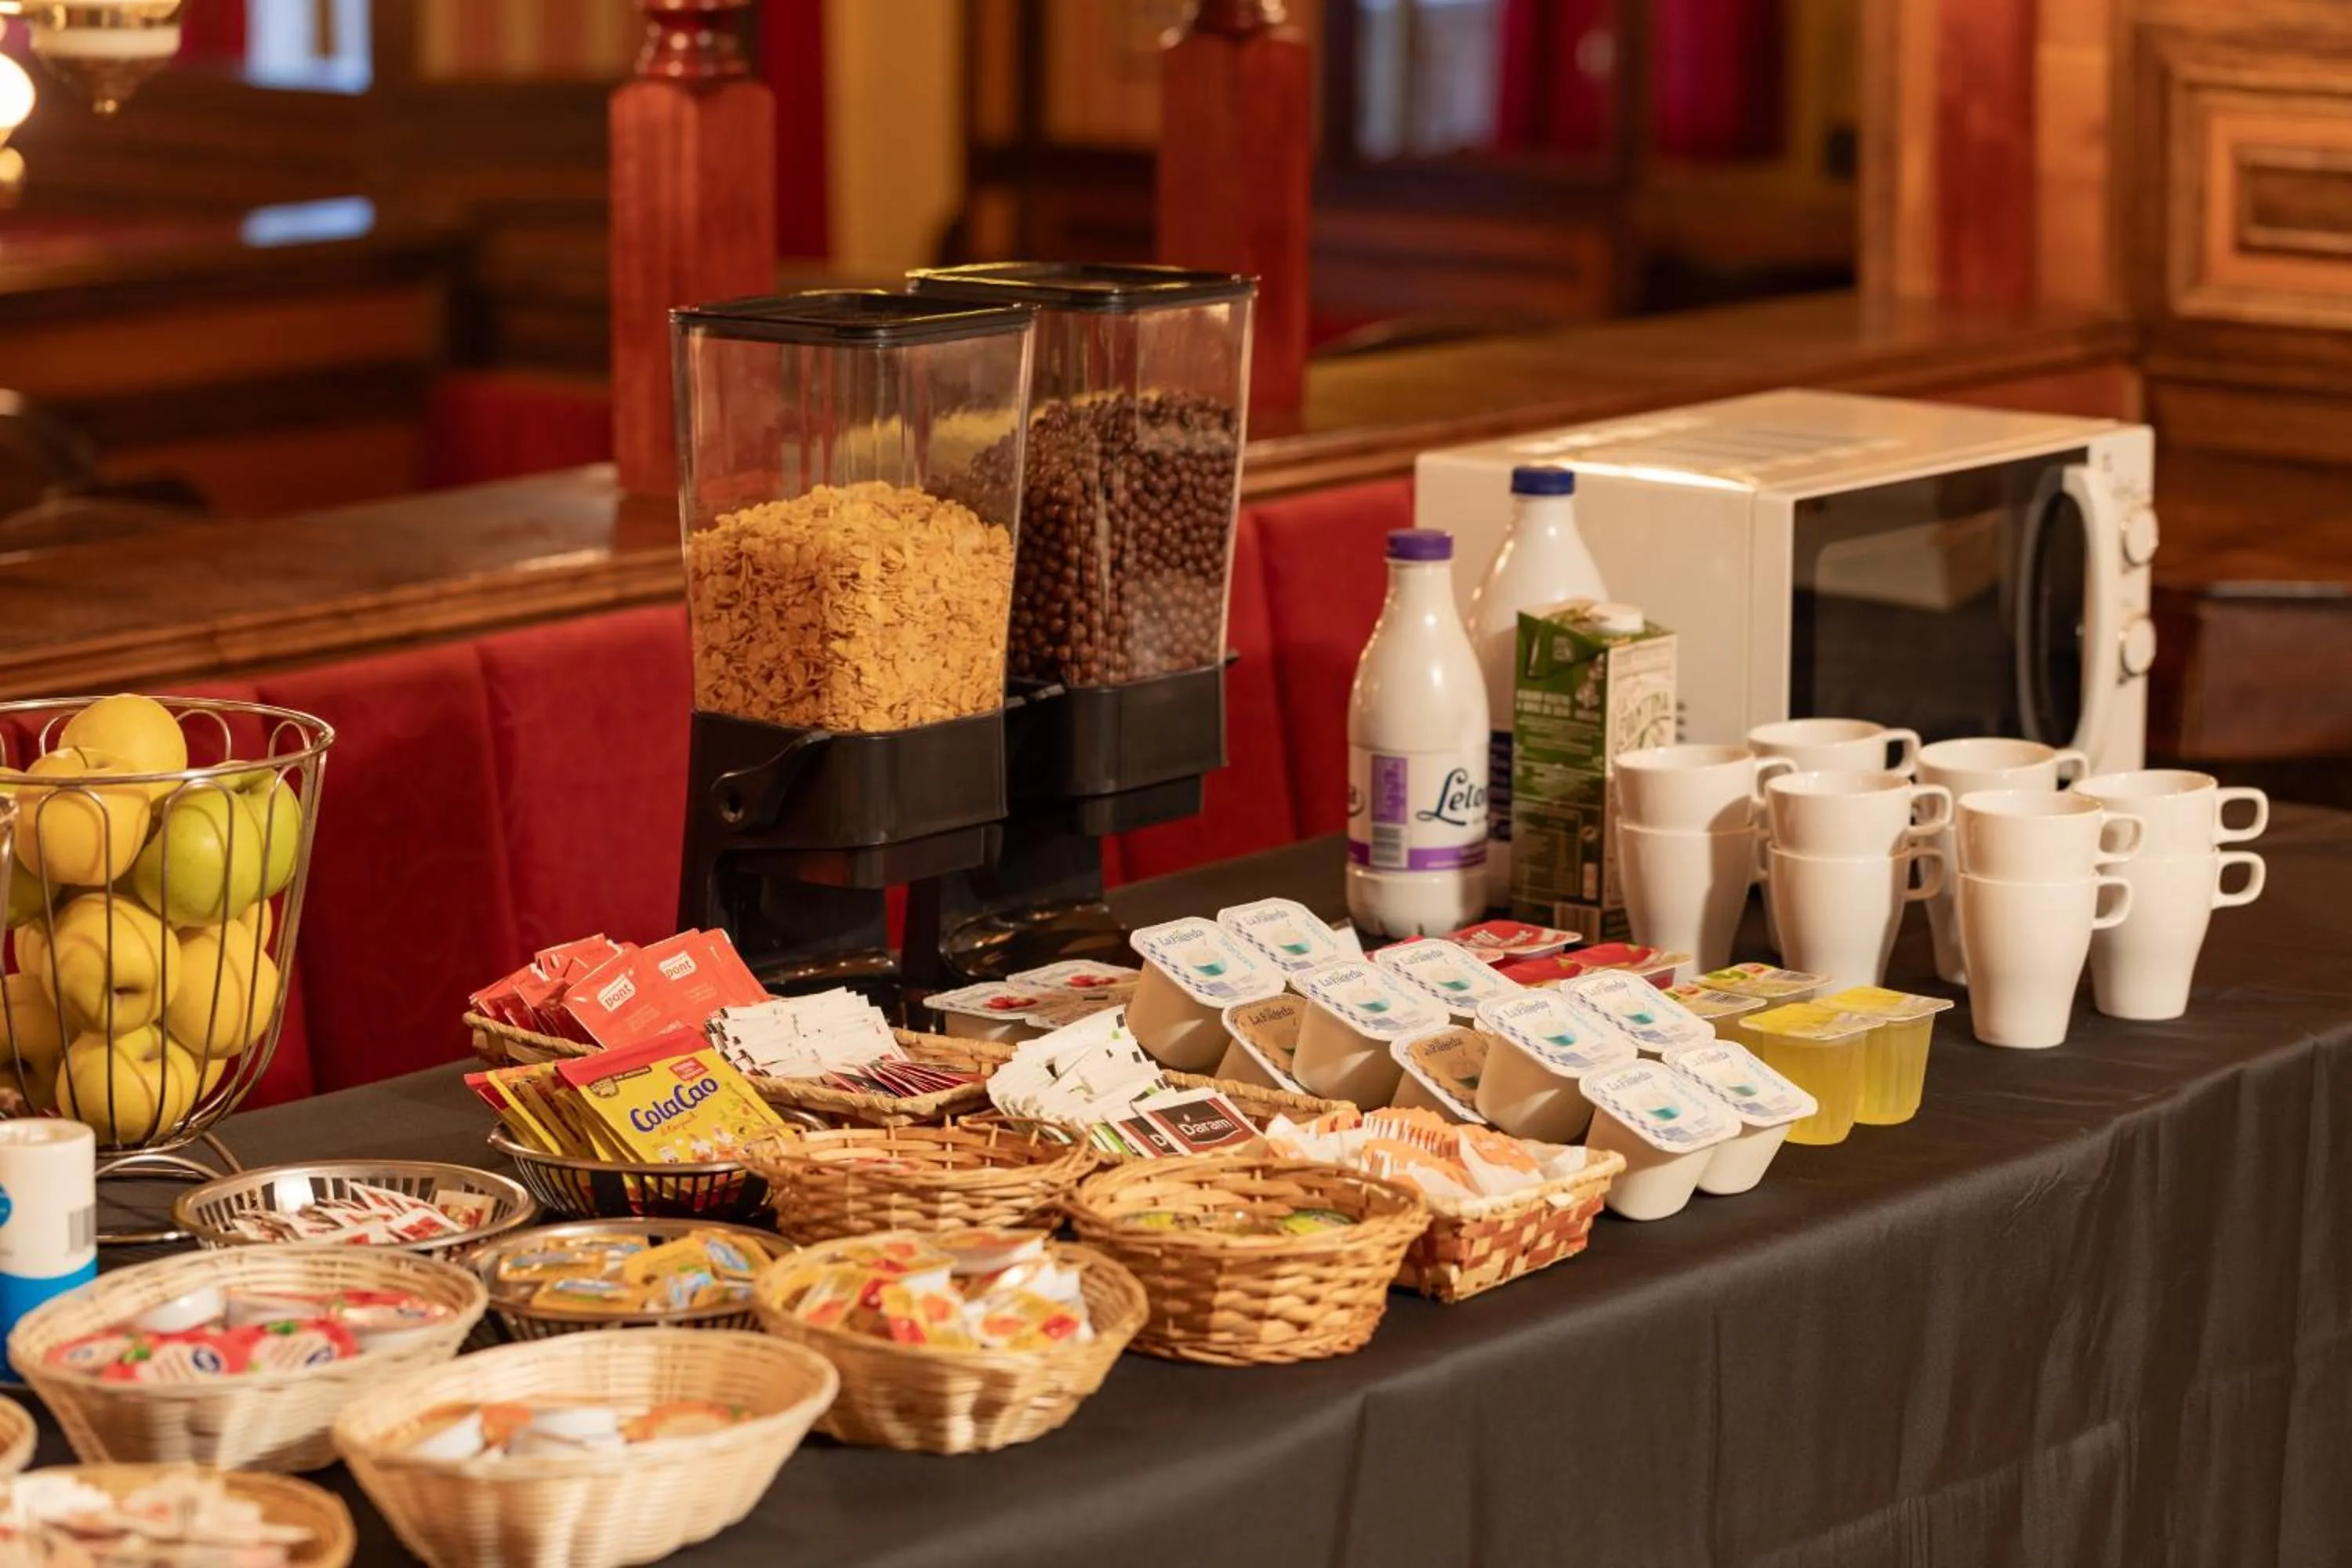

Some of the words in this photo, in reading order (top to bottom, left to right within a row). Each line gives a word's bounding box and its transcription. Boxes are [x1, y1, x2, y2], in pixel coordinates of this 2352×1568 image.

[604, 985, 632, 1008] pont
[630, 1078, 718, 1132] ColaCao
[1178, 1118, 1233, 1136] Daram
